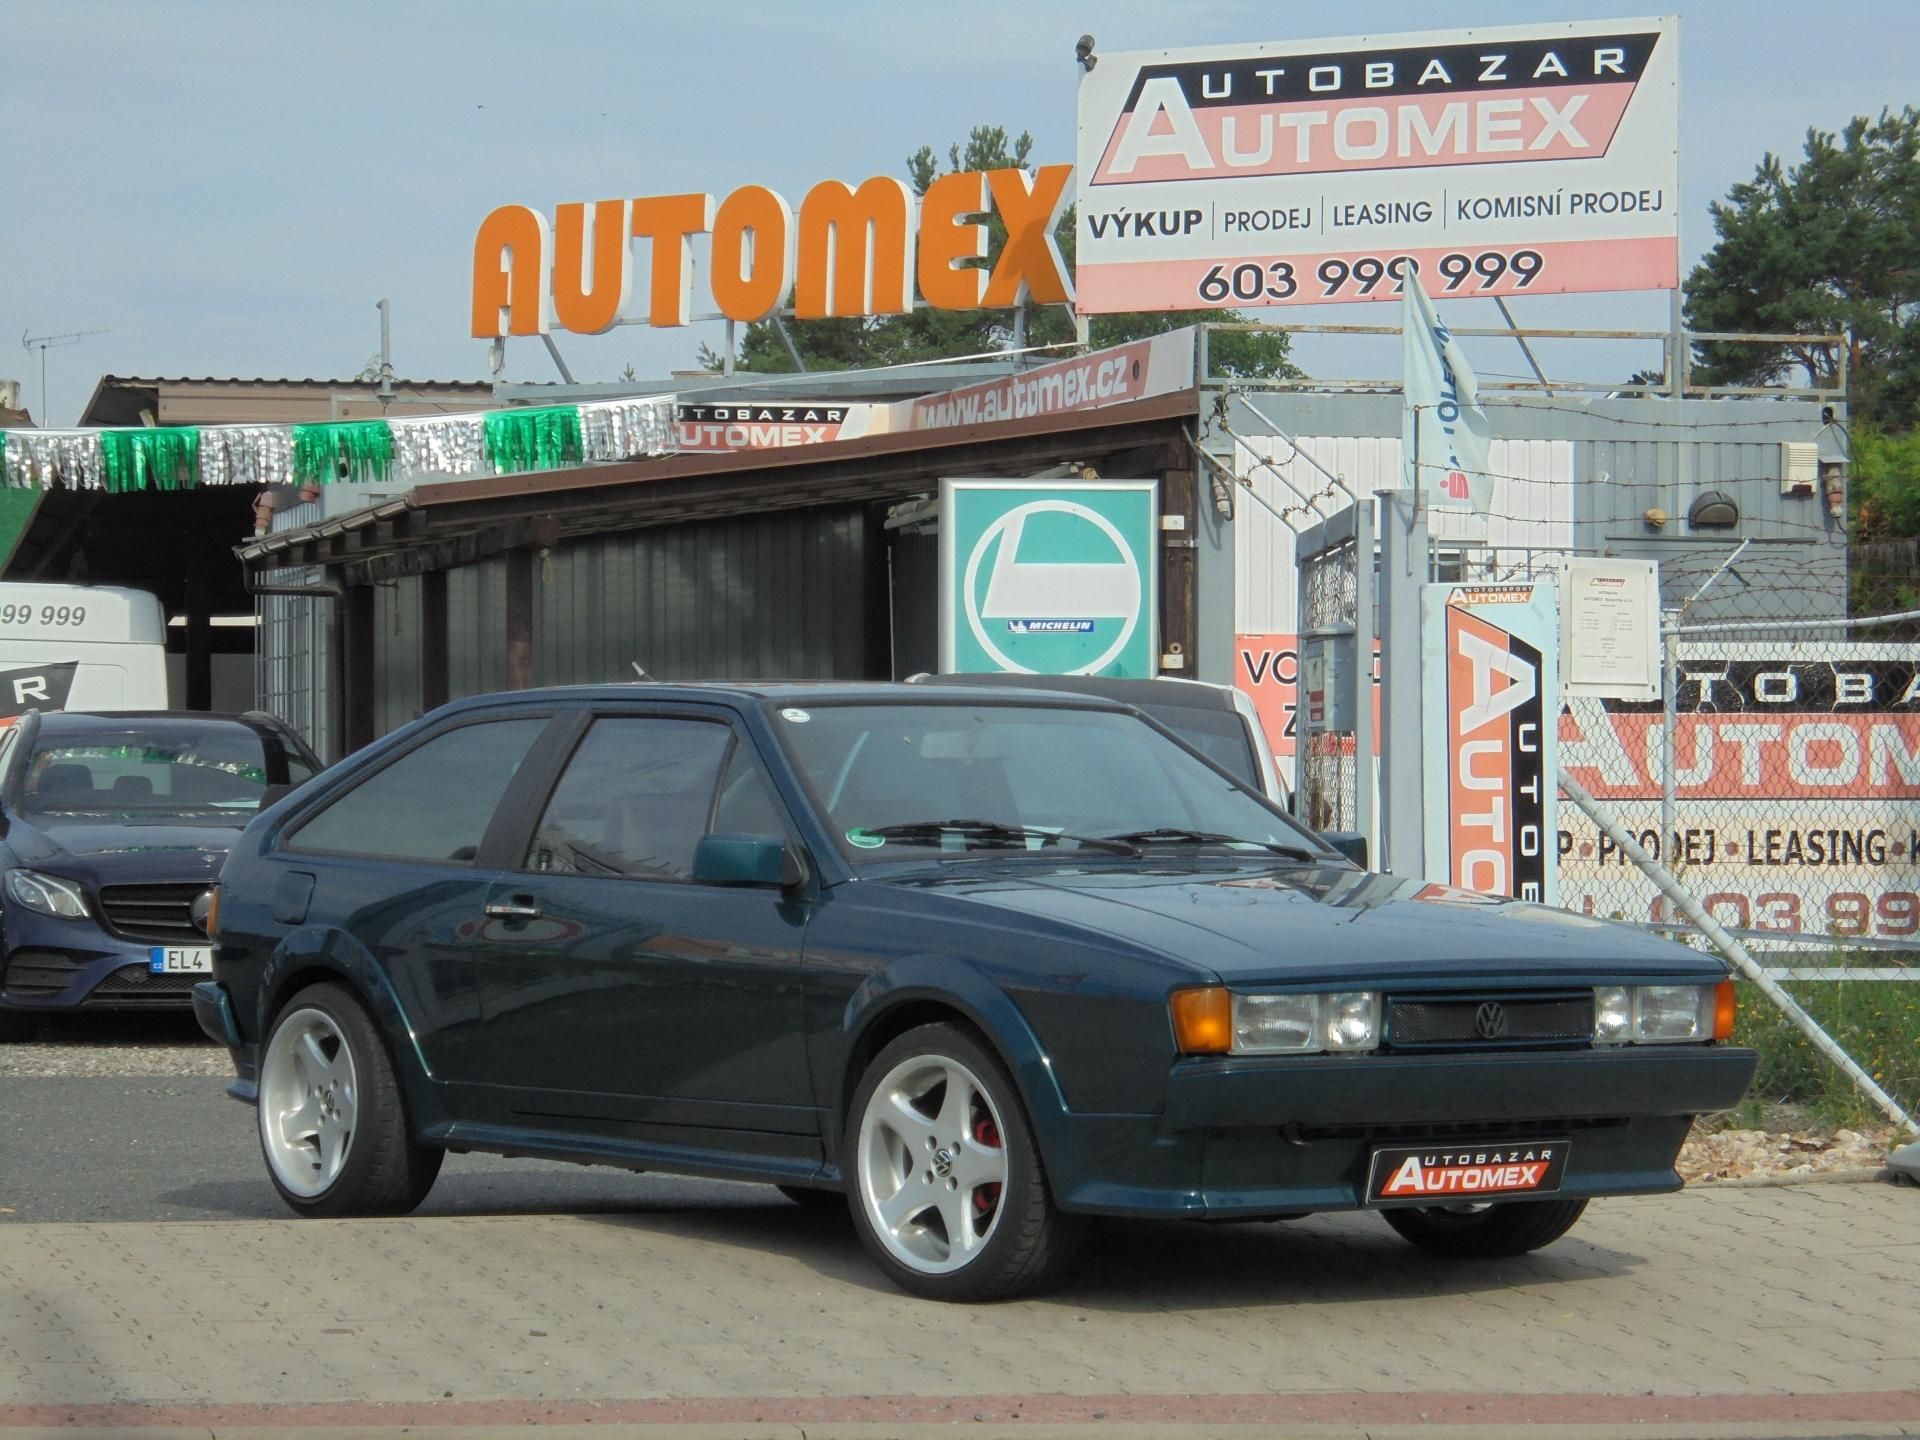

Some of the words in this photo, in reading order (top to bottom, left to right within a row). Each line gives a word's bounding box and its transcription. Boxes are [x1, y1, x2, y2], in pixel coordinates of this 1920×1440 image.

[1107, 76, 1590, 175] AUTOMEX
[1087, 206, 1203, 240] VÝKUP
[1224, 207, 1312, 233] PRODEJ
[1333, 201, 1433, 227] LEASING
[1457, 187, 1563, 220] KOMISNÍ
[1570, 190, 1663, 215] PRODEJ
[472, 163, 1075, 339] AUTOMEX
[1198, 260, 1297, 302] 603
[1317, 255, 1419, 298] 999
[1438, 250, 1543, 292] 999
[923, 355, 1128, 429] www.automex.cz
[679, 425, 827, 447] UTOMEX
[1448, 588, 1528, 604] AUTOMEX
[0, 604, 32, 625] 99
[40, 606, 86, 627] 999
[1029, 621, 1091, 630] MICHELIN
[1747, 829, 1886, 866] LEASING
[168, 950, 203, 969] EL4
[1388, 1156, 1538, 1192] AUTOMEX
